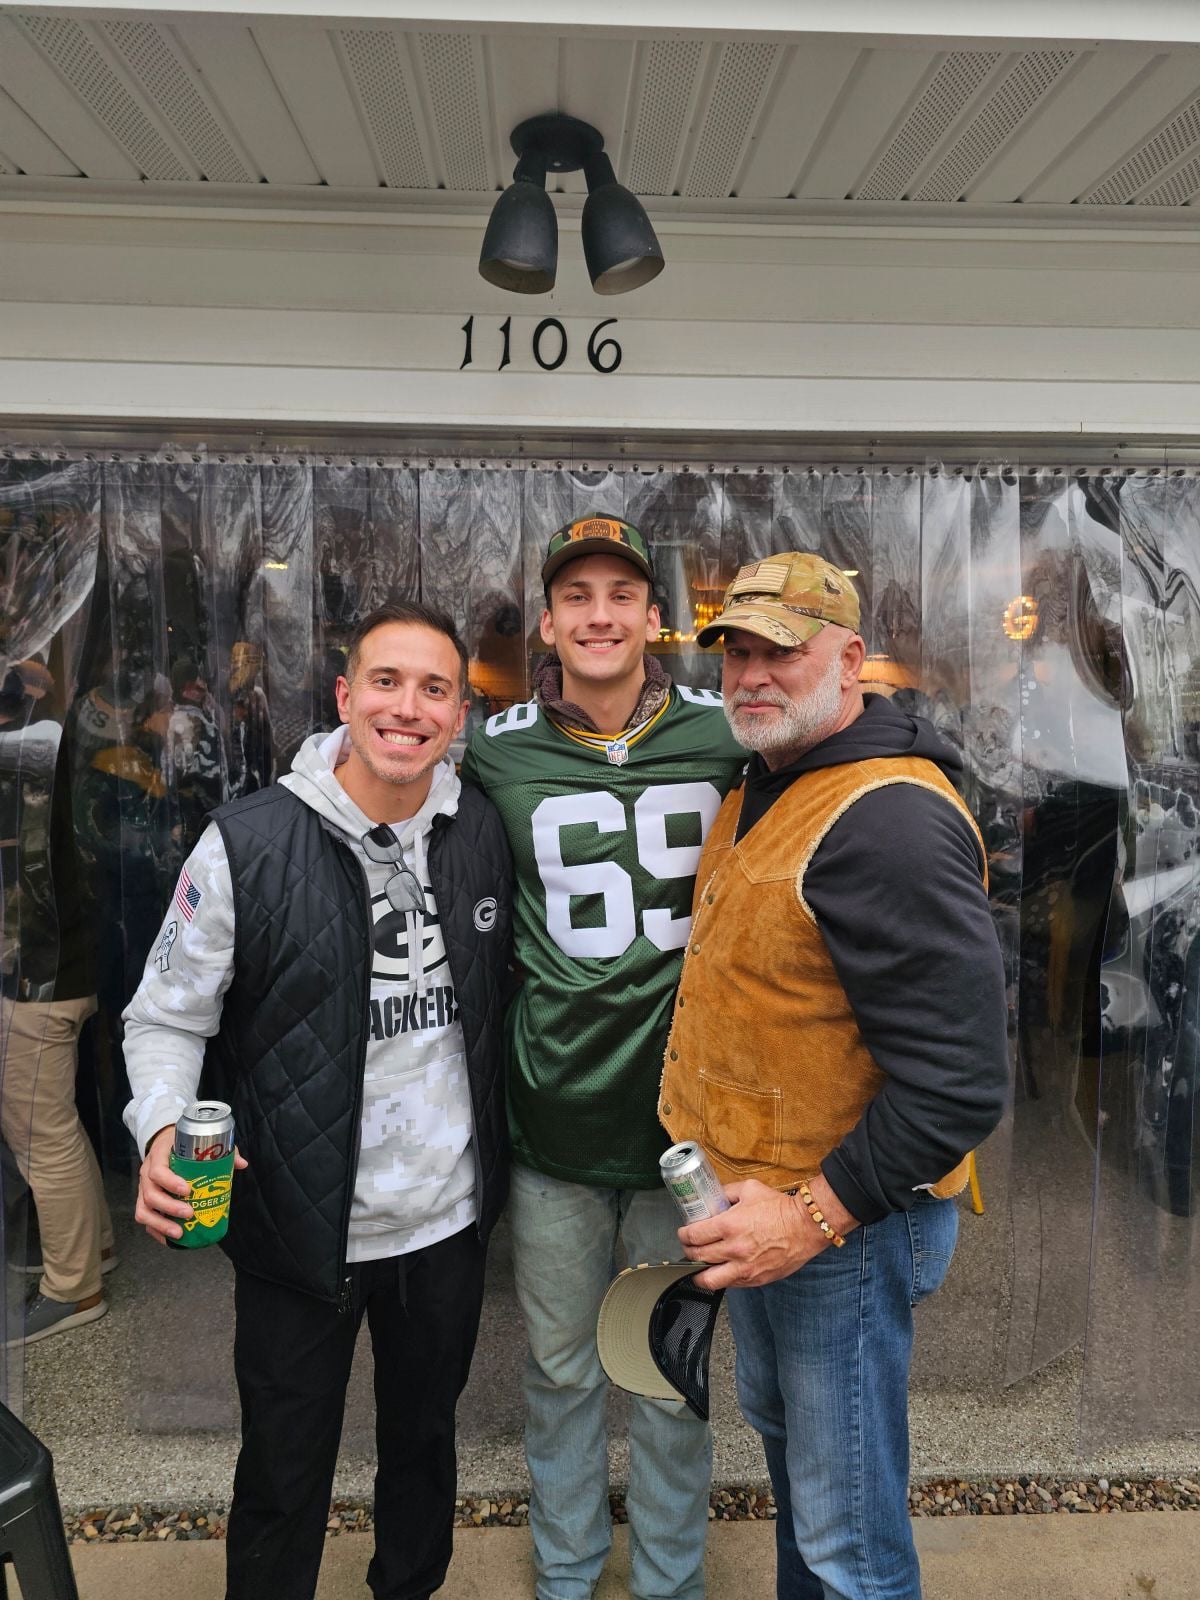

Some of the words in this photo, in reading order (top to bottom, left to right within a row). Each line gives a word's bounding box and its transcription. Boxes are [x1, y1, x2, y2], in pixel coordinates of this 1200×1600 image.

[460, 315, 622, 373] 1106
[1003, 596, 1038, 640] G
[485, 703, 538, 737] 9
[609, 750, 626, 762] NFL
[531, 782, 722, 958] 69
[473, 897, 497, 931] G
[368, 985, 459, 1041] ACKER
[191, 1198, 218, 1209] DGER
